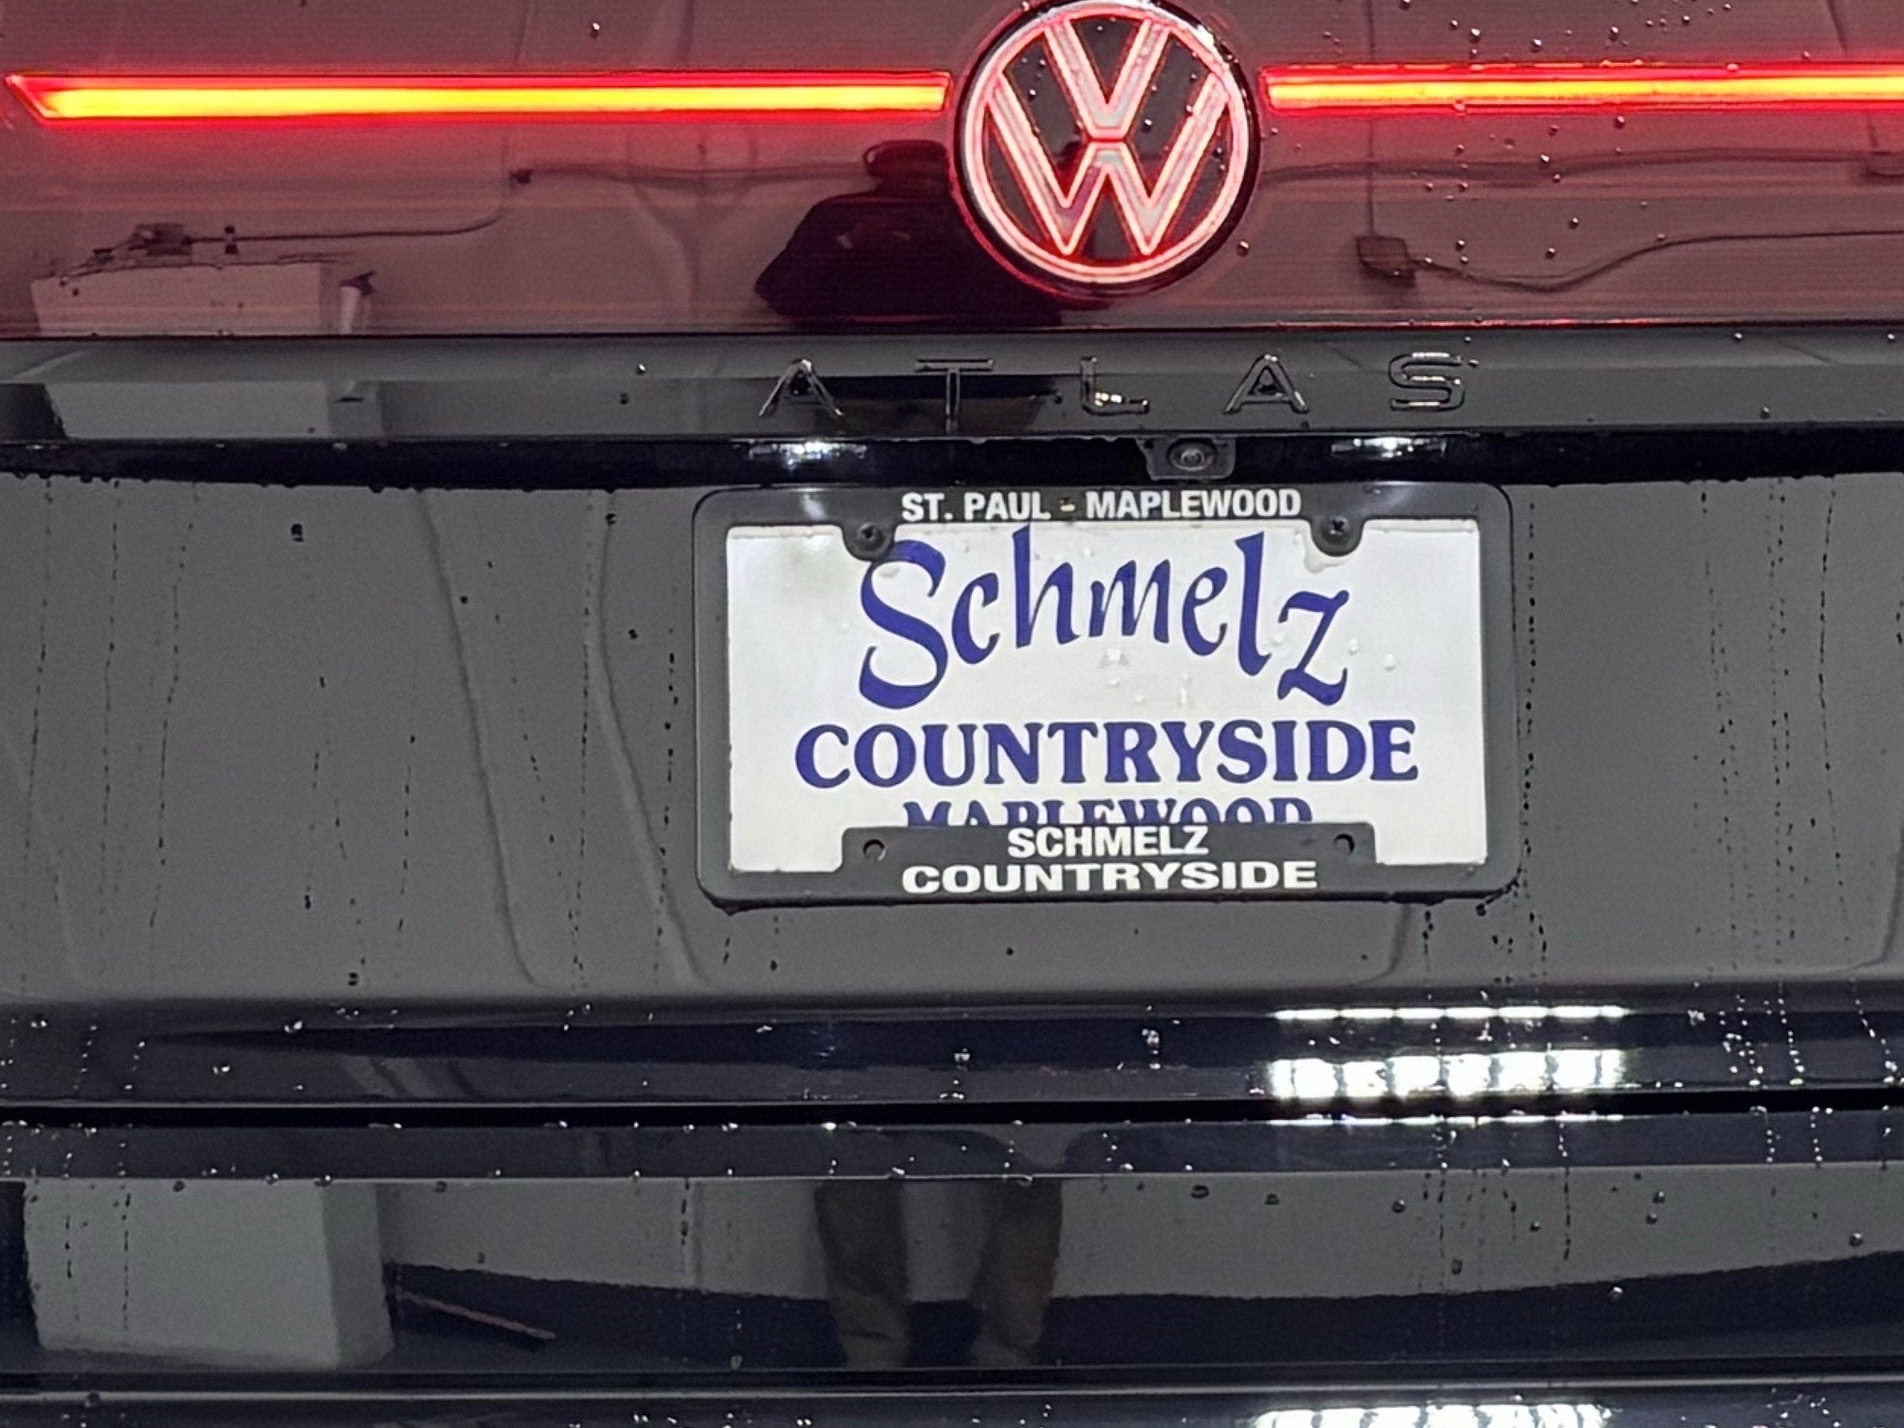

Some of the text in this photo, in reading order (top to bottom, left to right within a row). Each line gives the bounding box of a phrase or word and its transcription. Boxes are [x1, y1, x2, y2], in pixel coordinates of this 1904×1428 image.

[758, 350, 1468, 420] ATLAS
[901, 492, 955, 522] ST.
[964, 492, 1051, 522] PAUL
[1085, 489, 1302, 519] MAPLEWOOD
[859, 525, 1350, 710] Schmelz
[794, 719, 1420, 789] COUNTRYSIDE
[1007, 828, 1210, 857] SCHMELZ
[901, 861, 1318, 893] COUNTRYSIDE
